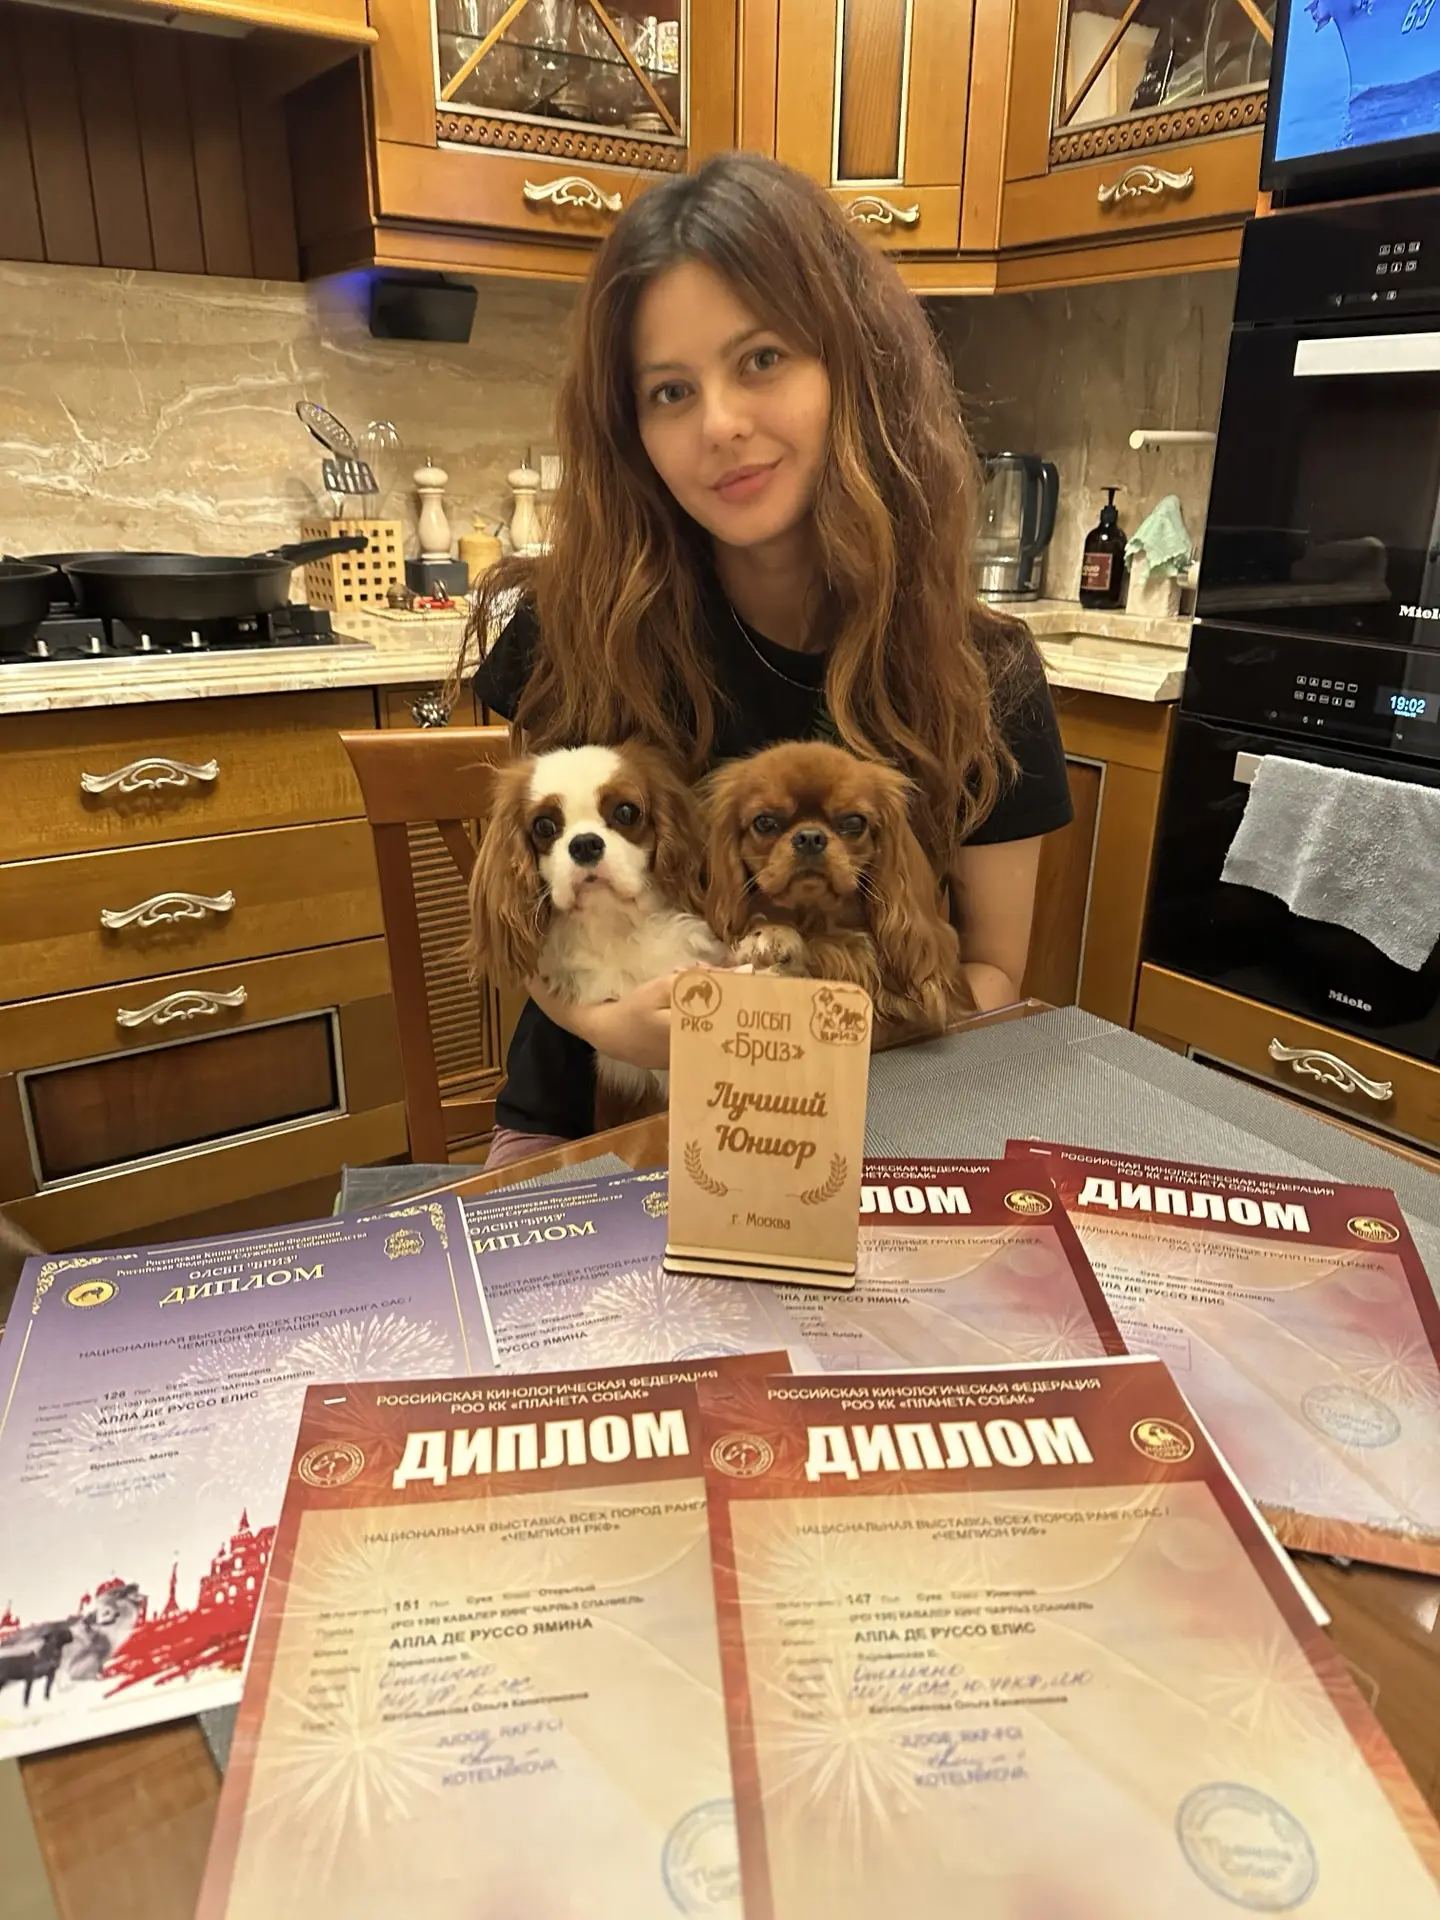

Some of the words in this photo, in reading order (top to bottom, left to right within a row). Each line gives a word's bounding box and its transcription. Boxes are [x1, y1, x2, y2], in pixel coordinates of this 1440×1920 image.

[1391, 696, 1425, 713] 19:02
[1328, 989, 1372, 1012] Miele
[681, 1017, 713, 1032] РКФ
[736, 1010, 792, 1032] ОЛСБП
[721, 1032, 806, 1066] «Бриз»
[707, 1081, 829, 1120] Лучший
[715, 1125, 817, 1170] Юниор
[920, 1165, 990, 1175] ФЕДЕРАЦИЯ
[1060, 1152, 1142, 1170] РОССИЙСКАЯ
[1143, 1163, 1257, 1187] КИНОЛОГИЧЕСКАЯ
[1258, 1180, 1336, 1197] ФЕДЕРАЦИЯ
[1117, 1168, 1144, 1178] РОО
[1146, 1171, 1161, 1180] КК
[859, 1186, 972, 1214] ЛОМ
[1077, 1176, 1312, 1234] ДИПЛОМ
[732, 1214, 743, 1226] г.
[746, 1212, 791, 1230] Москва
[473, 1220, 598, 1254] ИПЛОМ
[189, 1265, 244, 1280] ОЛСБП
[491, 1274, 549, 1289] ВЫСТАВКА
[552, 1269, 581, 1279] ВСЕХ
[583, 1260, 623, 1274] ПОРОД
[624, 1254, 658, 1267] РАНГА
[159, 1264, 325, 1308] ДИПЛОМ
[823, 1295, 864, 1303] РУССО
[867, 1296, 910, 1304] ЯМИНА
[1145, 1288, 1188, 1300] РУССО
[1191, 1295, 1224, 1306] ЕЛИС
[79, 1336, 185, 1359] НАЦИОНАЛЬНАЯ
[188, 1323, 255, 1342] ВЫСТАВКА
[257, 1318, 293, 1330] ВСЕХ
[294, 1310, 338, 1325] ПОРОД
[339, 1303, 379, 1317] РАНГА
[177, 1334, 242, 1350] ЧЕМПИОН
[243, 1320, 320, 1341] ФЕДЕРАЦИИ
[543, 1331, 588, 1346] ЯМИНА
[377, 1388, 483, 1406] РОССИЙСКАЯ
[486, 1378, 626, 1401] КИНОЛОГИЧЕСКАЯ
[450, 1403, 485, 1415] РОО
[488, 1401, 507, 1412] КК
[511, 1395, 589, 1411] «ПЛАНЕТА
[592, 1389, 650, 1405] СОБАК»
[768, 1386, 869, 1401] РОССИЙСКАЯ
[872, 1381, 1008, 1399] КИНОЛОГИЧЕСКАЯ
[1011, 1378, 1101, 1394] ФЕДЕРАЦИЯ
[841, 1399, 876, 1411] РОО
[878, 1398, 897, 1410] КК
[899, 1395, 976, 1410] «ПЛАНЕТА
[978, 1393, 1035, 1407] СОБАК»
[98, 1412, 139, 1425] АЛЛА
[167, 1398, 217, 1414] РУССО
[221, 1390, 258, 1404] ЕЛИС
[392, 1408, 691, 1490] ДИПЛОМ
[805, 1416, 1094, 1483] ДИПЛОМ
[363, 1523, 486, 1544] НАЦИОНАЛЬНАЯ
[489, 1515, 566, 1532] ВЫСТАВКА
[569, 1510, 607, 1523] ВСЕХ
[610, 1503, 662, 1520] ПОРОД
[501, 1525, 581, 1542] «ЧЕМПИОН
[584, 1522, 621, 1535] РКФ»
[796, 1519, 914, 1536] НАЦИОНАЛЬНАЯ
[916, 1516, 992, 1530] ВЫСТАВКА
[993, 1513, 1032, 1526] ВСЕХ
[1033, 1510, 1084, 1525] ПОРОД
[1085, 1508, 1131, 1522] РАНГА
[932, 1528, 1009, 1542] «ЧЕМПИОН
[443, 1610, 498, 1623] КАВАЛЕР
[390, 1634, 437, 1650] АЛЛА
[442, 1631, 466, 1646] ДЕ
[470, 1624, 529, 1642] РУССО
[533, 1617, 593, 1635] ЯМИНА
[854, 1630, 900, 1643] АЛЛА
[904, 1628, 927, 1642] ДЕ
[931, 1623, 987, 1639] РУССО
[990, 1622, 1036, 1637] ЕЛИС
